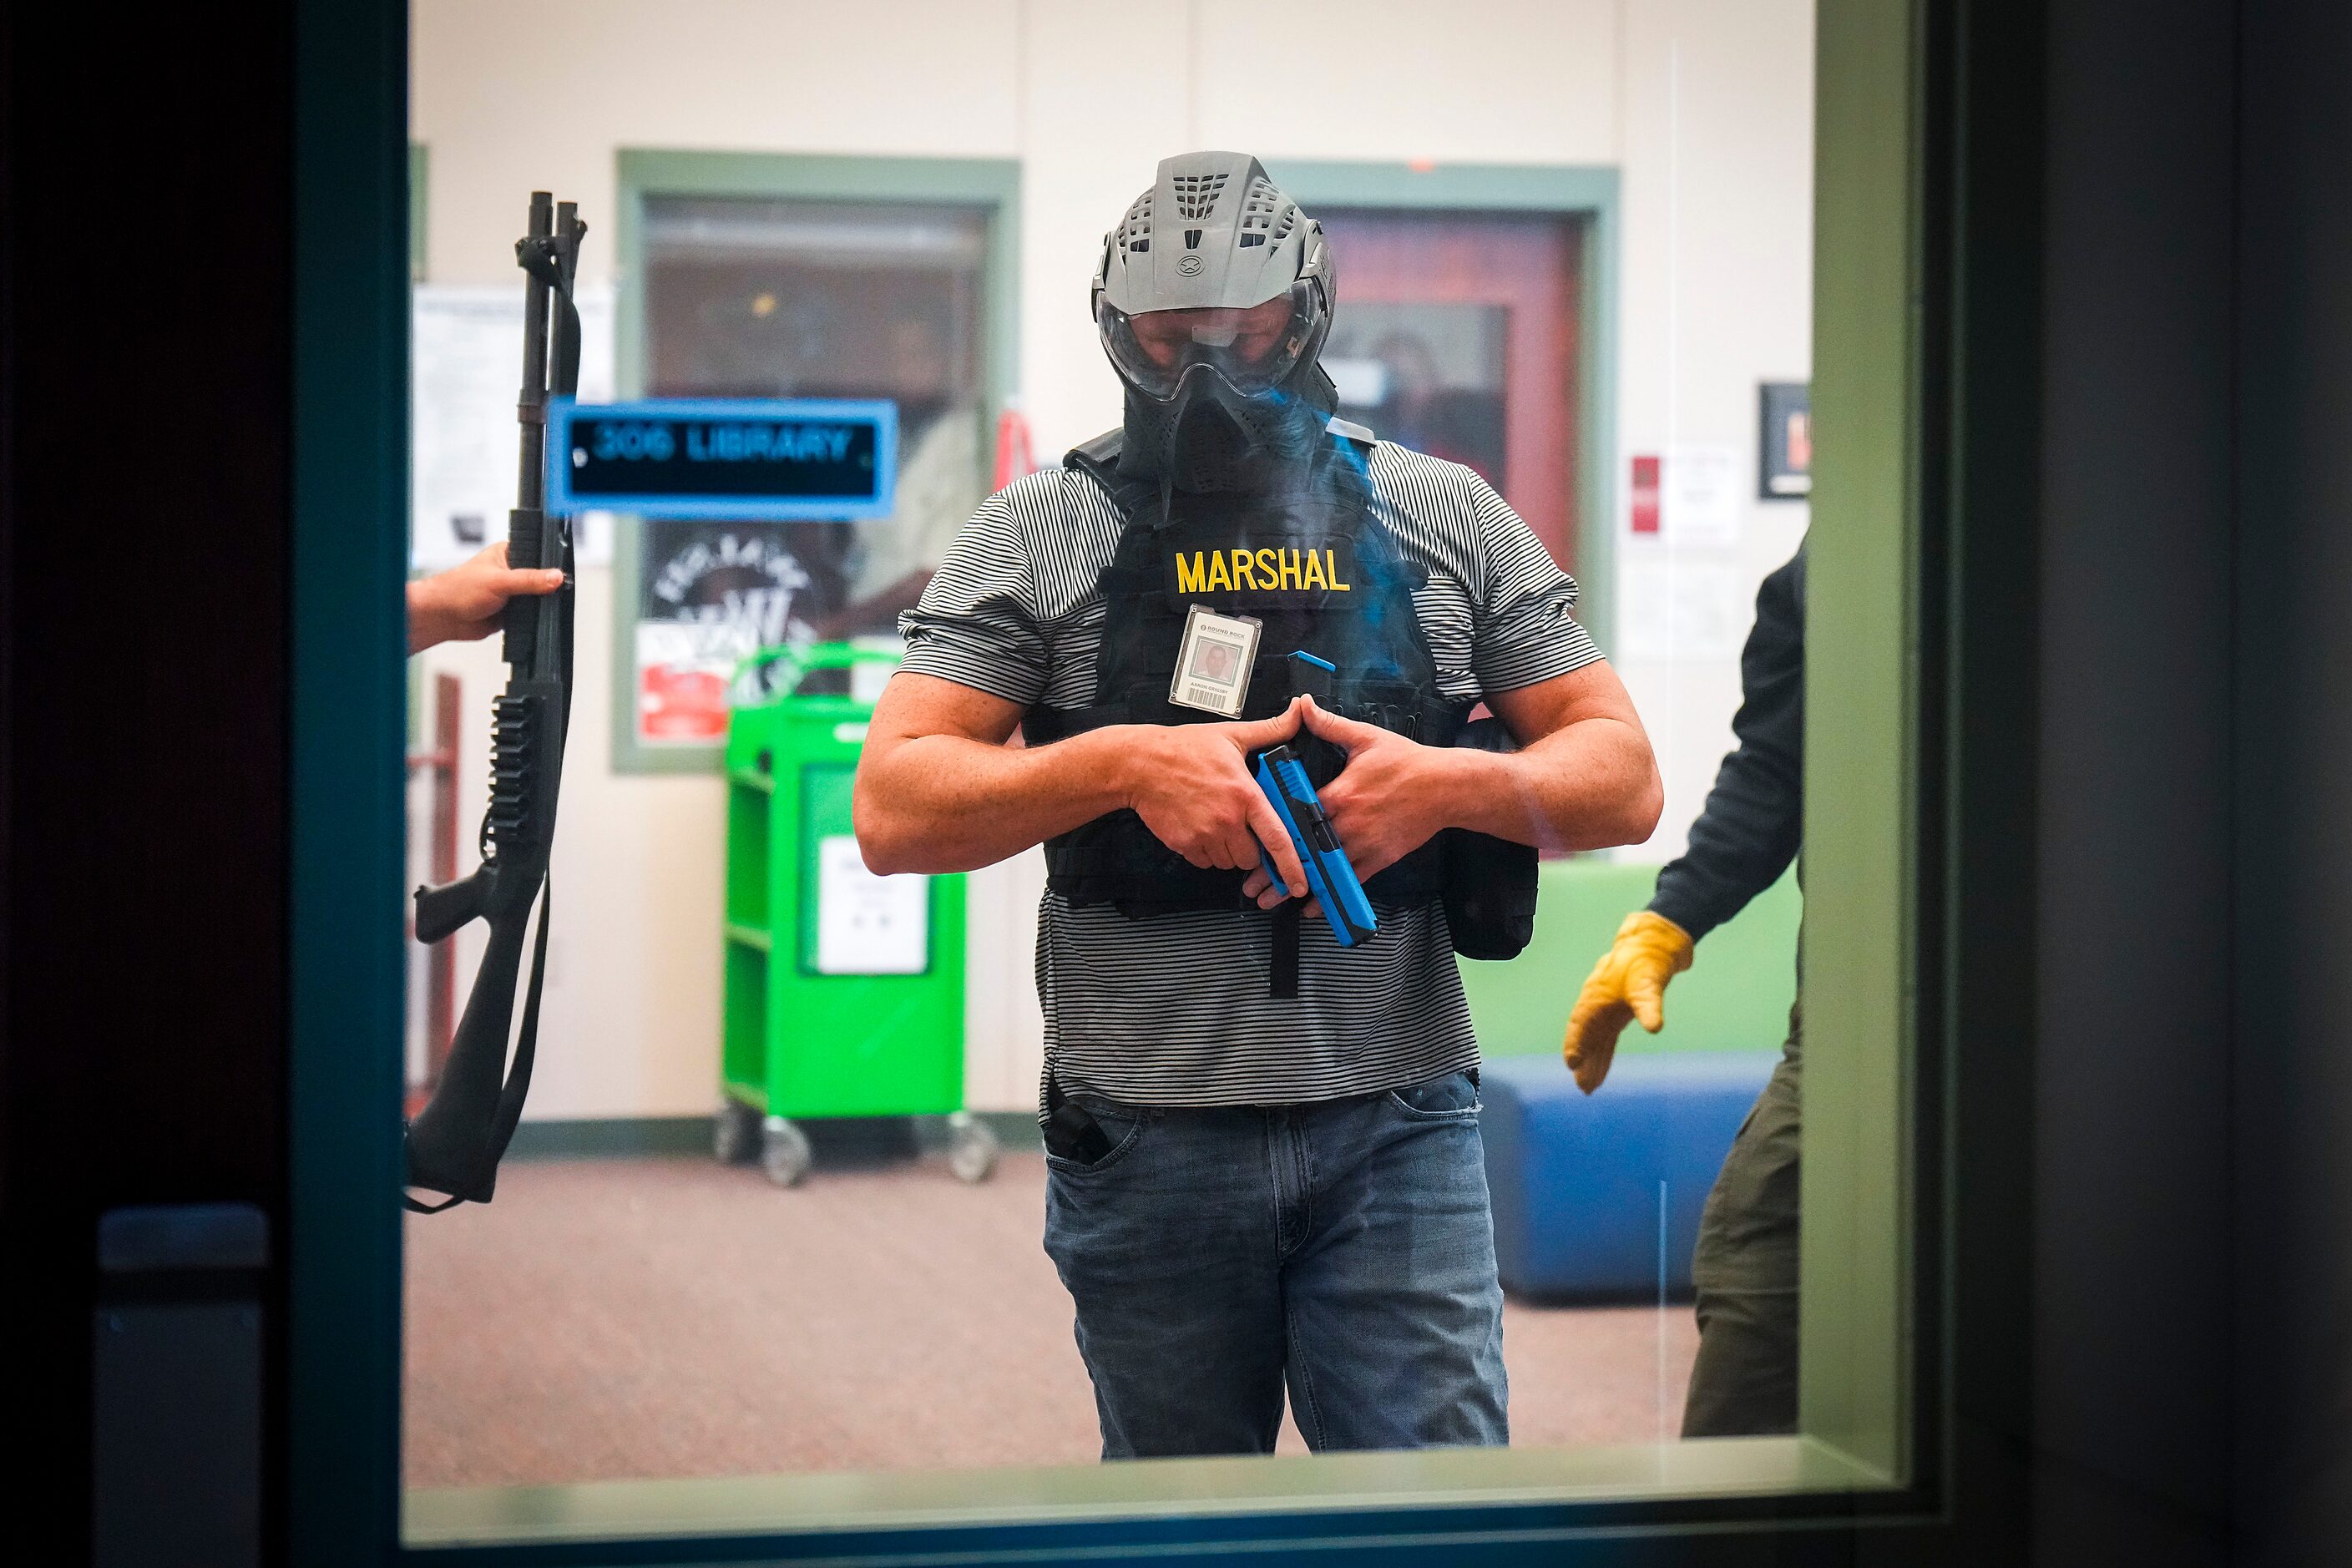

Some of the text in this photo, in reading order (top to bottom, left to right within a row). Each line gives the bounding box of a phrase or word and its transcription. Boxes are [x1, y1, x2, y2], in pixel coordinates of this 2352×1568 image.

[594, 424, 852, 463] 306 LIBRARY
[1176, 547, 1351, 594] MARSHAL
[1207, 625, 1228, 635] ROUND
[1229, 631, 1245, 640] ROCK
